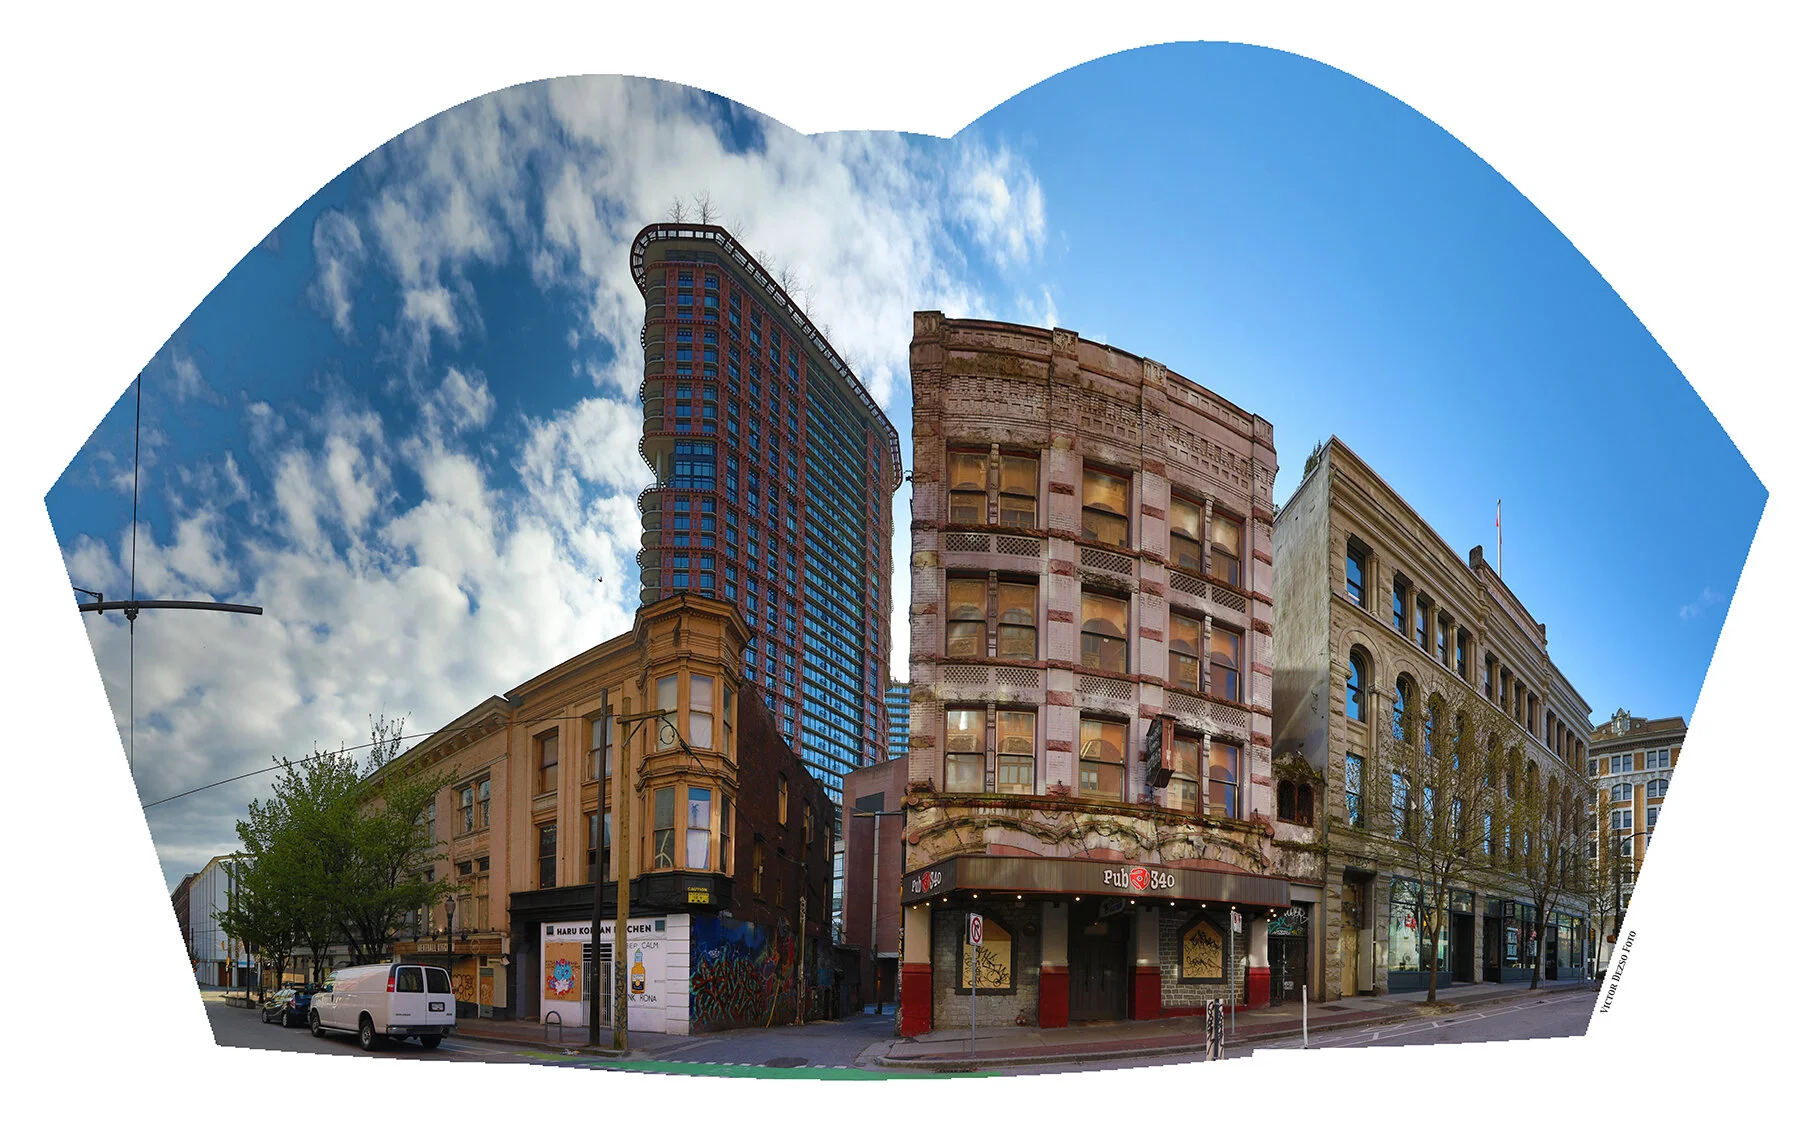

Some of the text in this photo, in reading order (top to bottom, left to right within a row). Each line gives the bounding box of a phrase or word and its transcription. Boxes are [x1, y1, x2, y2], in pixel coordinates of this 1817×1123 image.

[911, 871, 942, 893] Pub 340
[1103, 868, 1175, 890] Pub 340
[556, 927, 577, 935] HARU
[579, 926, 611, 935] KOAN
[641, 941, 659, 949] CALM
